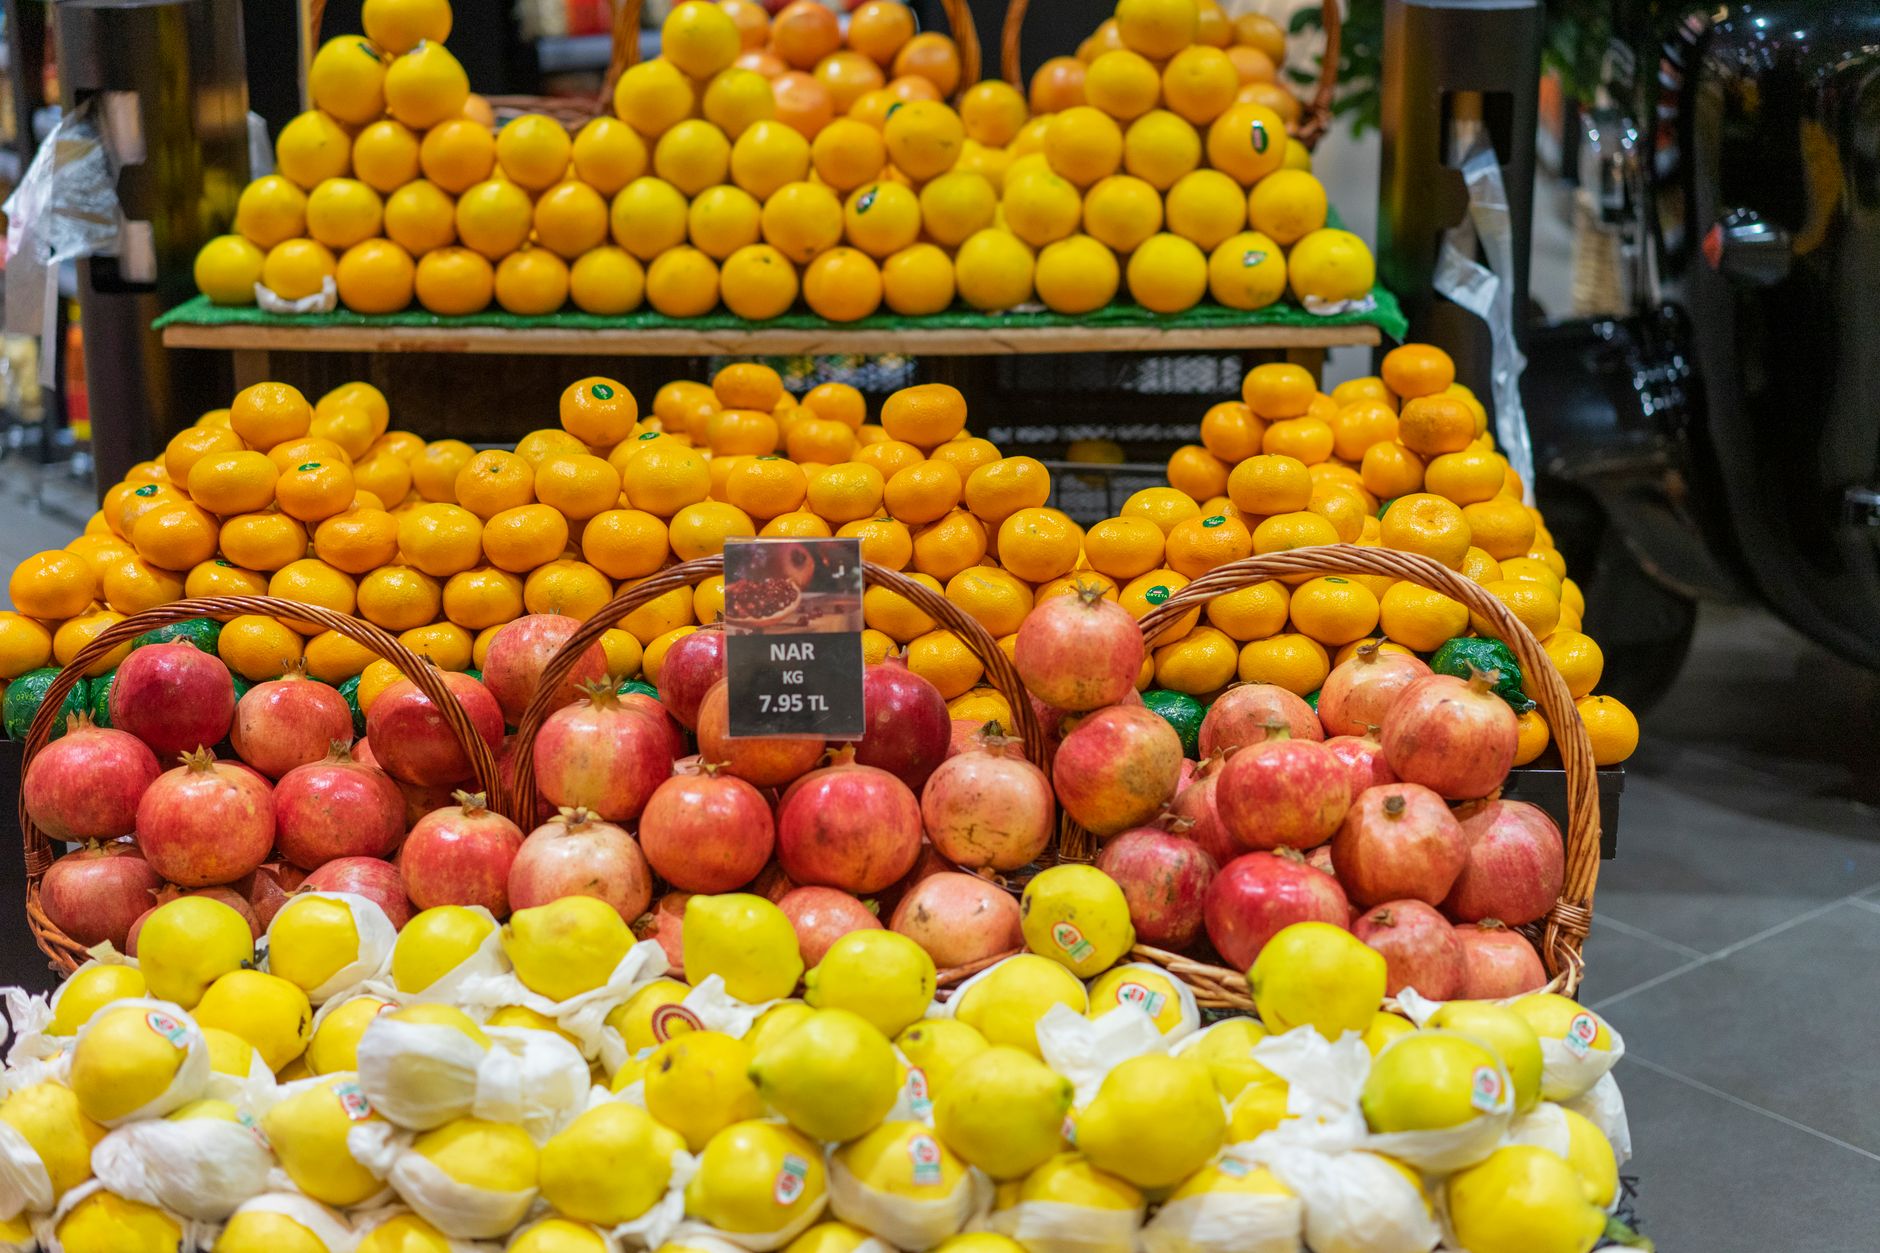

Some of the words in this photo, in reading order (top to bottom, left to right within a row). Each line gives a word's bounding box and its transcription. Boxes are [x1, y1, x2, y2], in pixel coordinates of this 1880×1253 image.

[770, 643, 815, 661] NAR
[782, 670, 804, 684] KG
[759, 694, 803, 712] 7.95
[807, 695, 829, 711] TL
